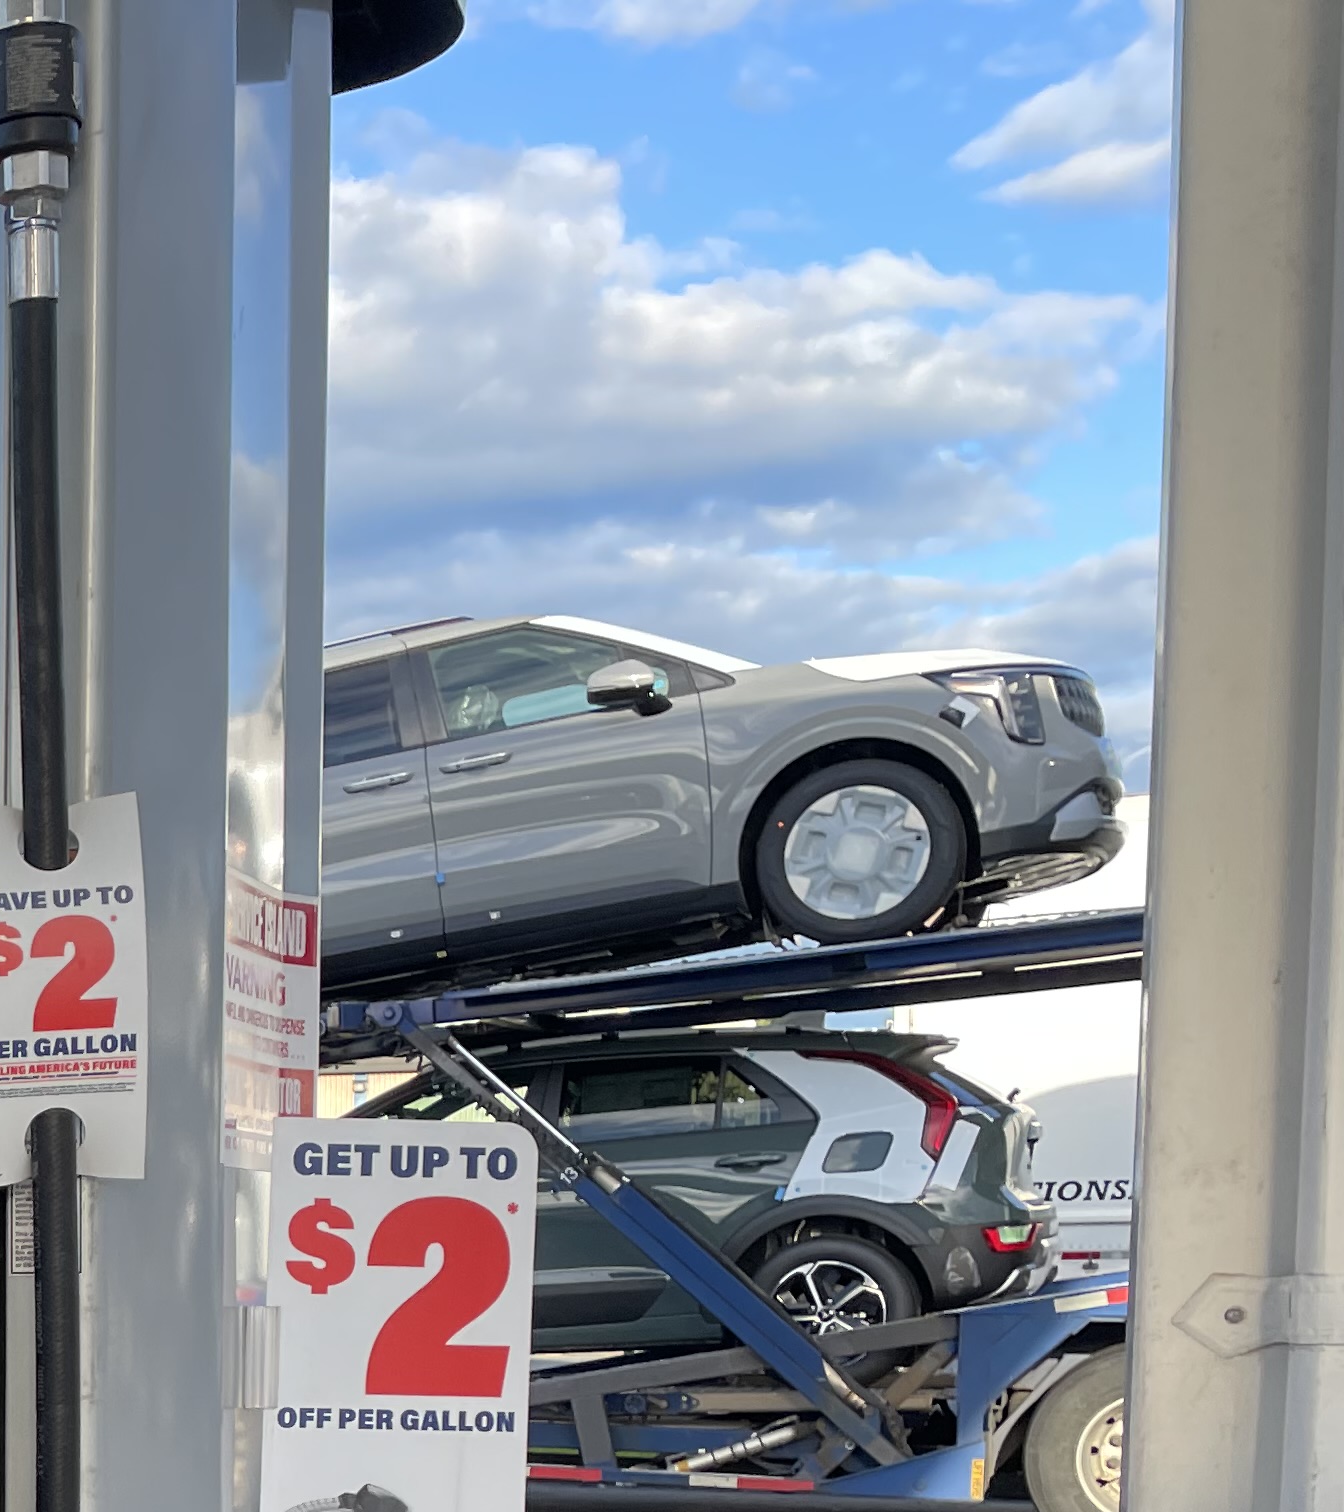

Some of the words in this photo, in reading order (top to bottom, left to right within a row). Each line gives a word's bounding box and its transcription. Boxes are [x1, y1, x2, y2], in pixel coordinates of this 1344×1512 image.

[52, 887, 91, 908] UP
[96, 885, 134, 905] TO
[32, 1032, 137, 1058] GALLON
[28, 1061, 90, 1074] AMERICA'S
[93, 1059, 137, 1070] FUTURE
[293, 1142, 381, 1176] GET
[390, 1145, 450, 1178] UP
[459, 1147, 518, 1181] TO
[277, 1406, 332, 1429] OFF
[338, 1408, 394, 1430] PER
[400, 1410, 515, 1432] GALLON
